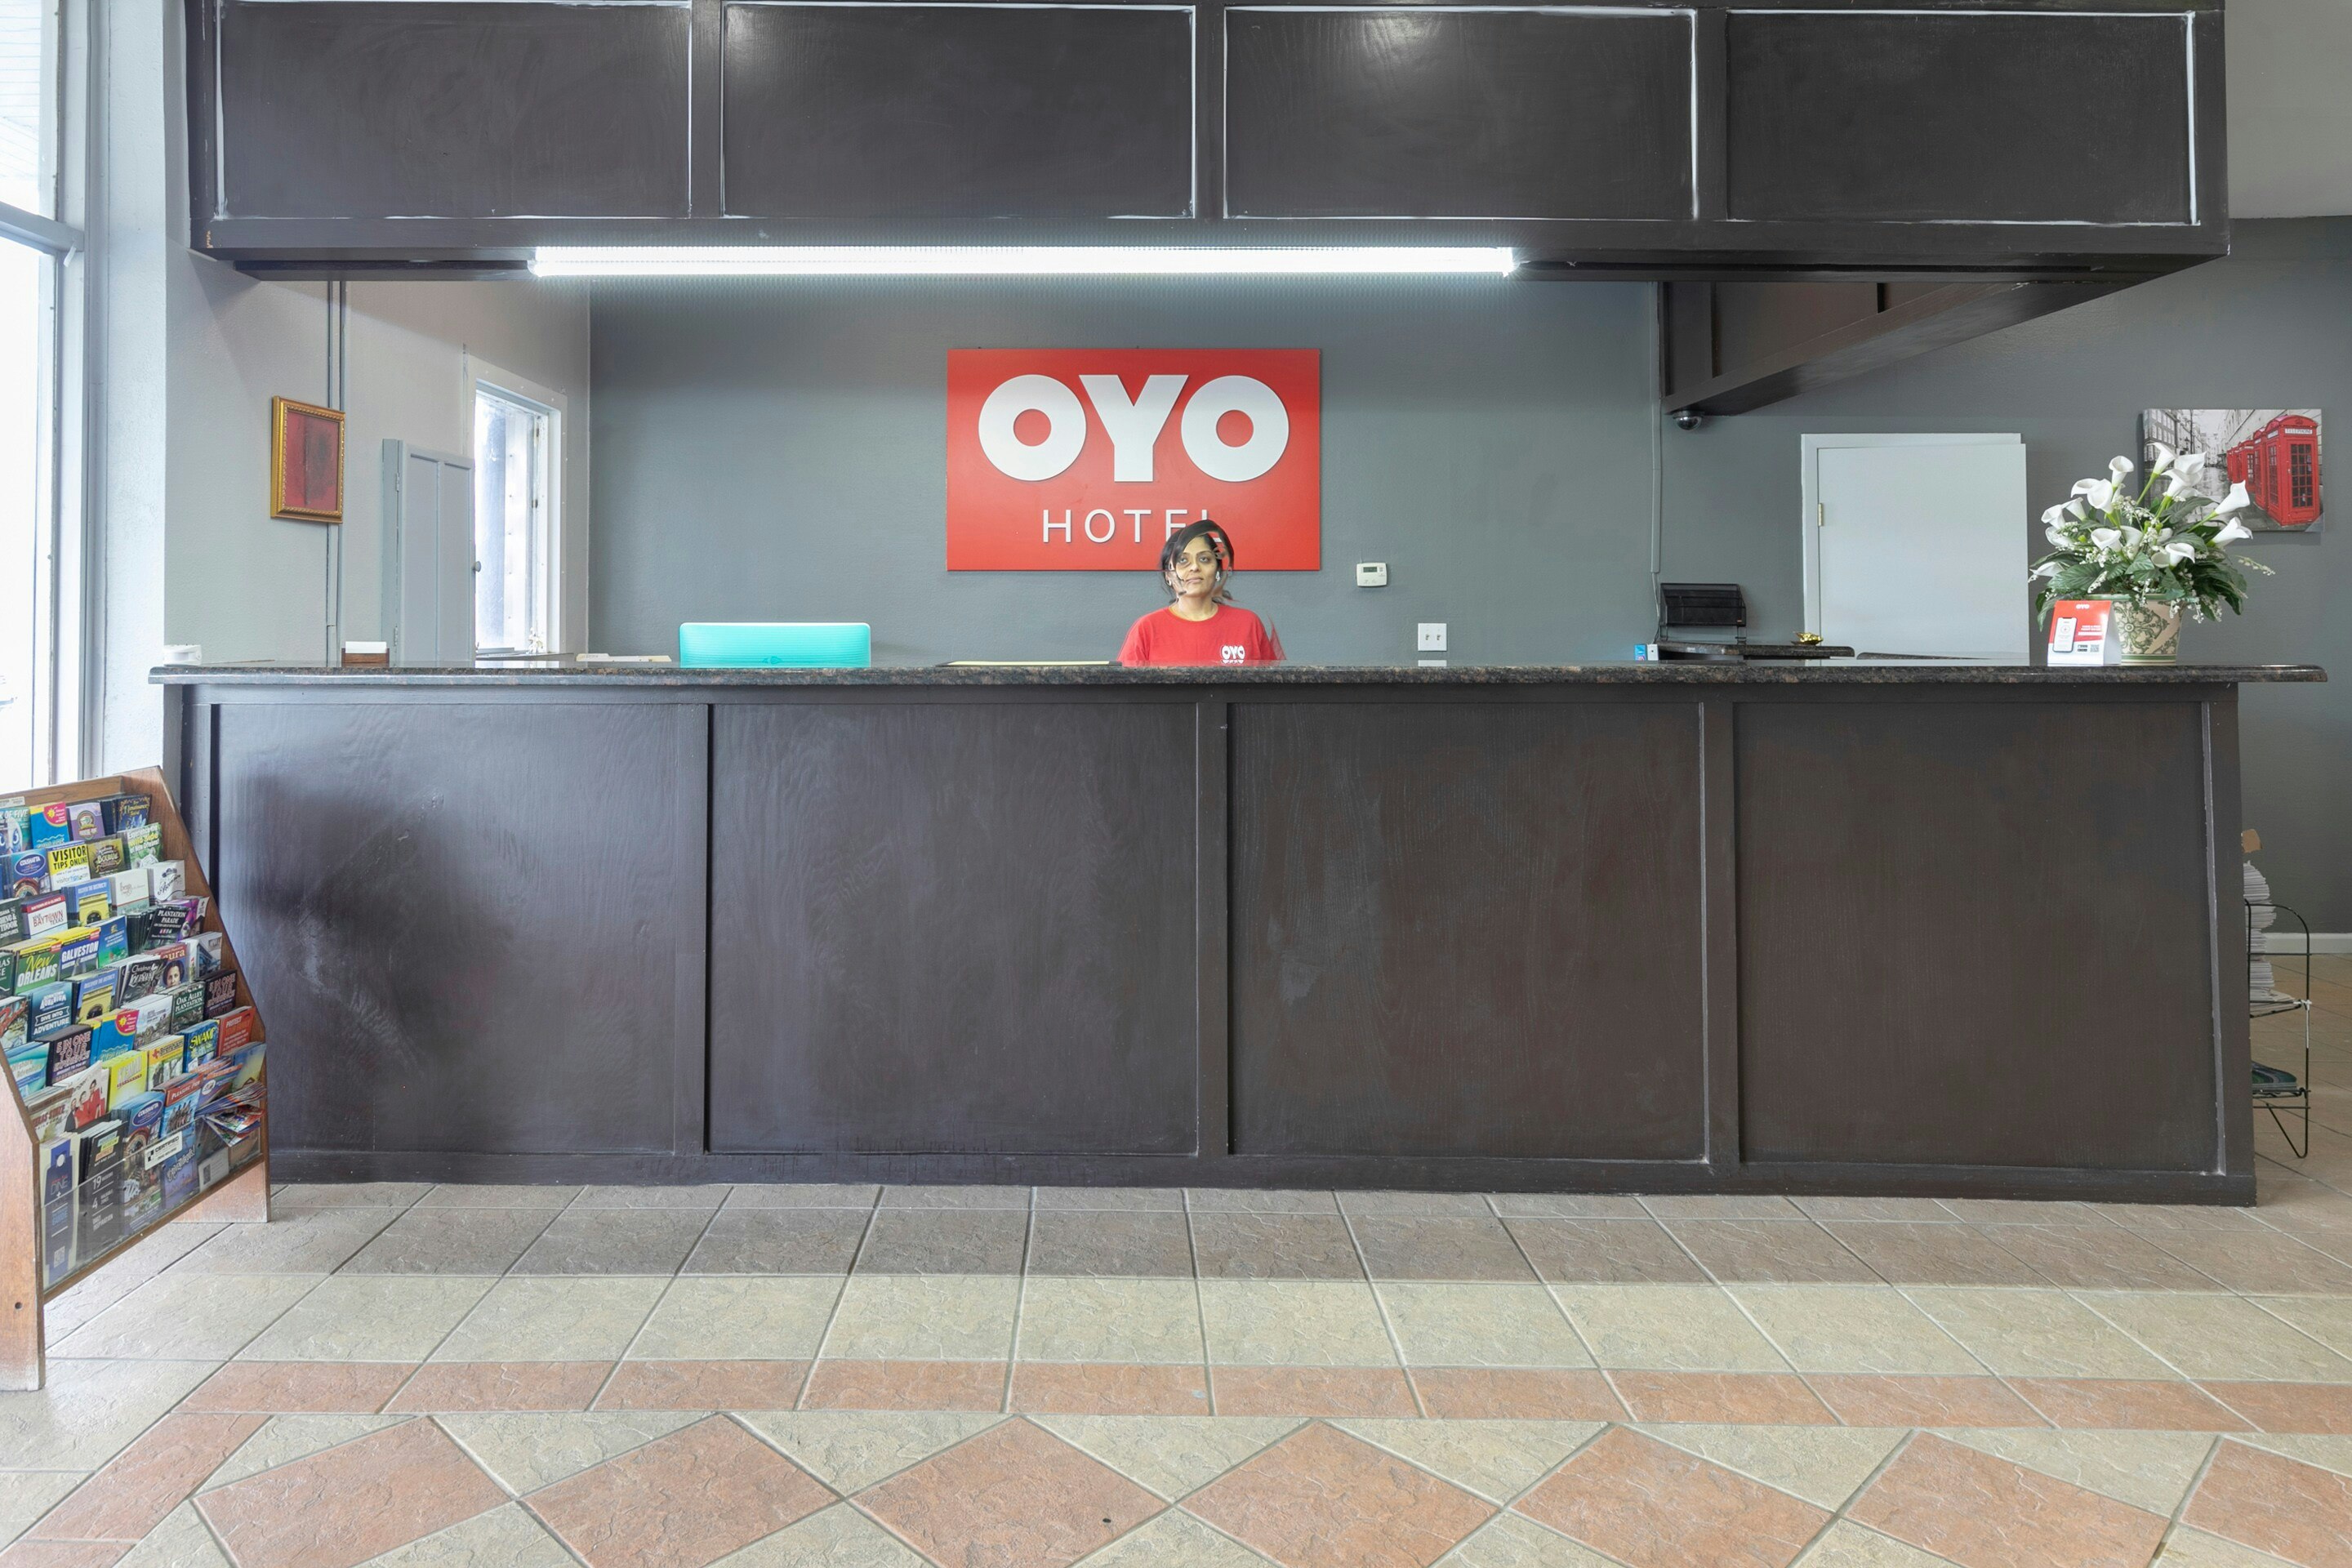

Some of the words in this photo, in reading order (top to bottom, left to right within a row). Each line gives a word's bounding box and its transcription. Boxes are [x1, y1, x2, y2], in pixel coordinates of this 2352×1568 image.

[978, 374, 1290, 482] OYO
[1222, 645, 1245, 660] OYO
[52, 845, 87, 862] VISITOR
[53, 862, 68, 871] TIPS
[69, 857, 88, 866] ONLINE
[33, 910, 64, 927] BAYTOWN
[51, 916, 64, 925] TEXAS
[158, 910, 186, 918] PLANTATION
[61, 941, 99, 963] GALVESTON
[25, 953, 56, 973] New
[17, 963, 58, 987] ORLEANS
[176, 996, 187, 1005] OAK
[188, 991, 203, 999] ALLEY
[176, 997, 203, 1012] PLANTATION
[41, 1014, 51, 1022] DIVE
[33, 1017, 69, 1035] ADVENTURE
[73, 1031, 91, 1045] ONE
[60, 1043, 87, 1062] TOUR
[92, 1175, 101, 1190] 19
[92, 1197, 98, 1209] 4
